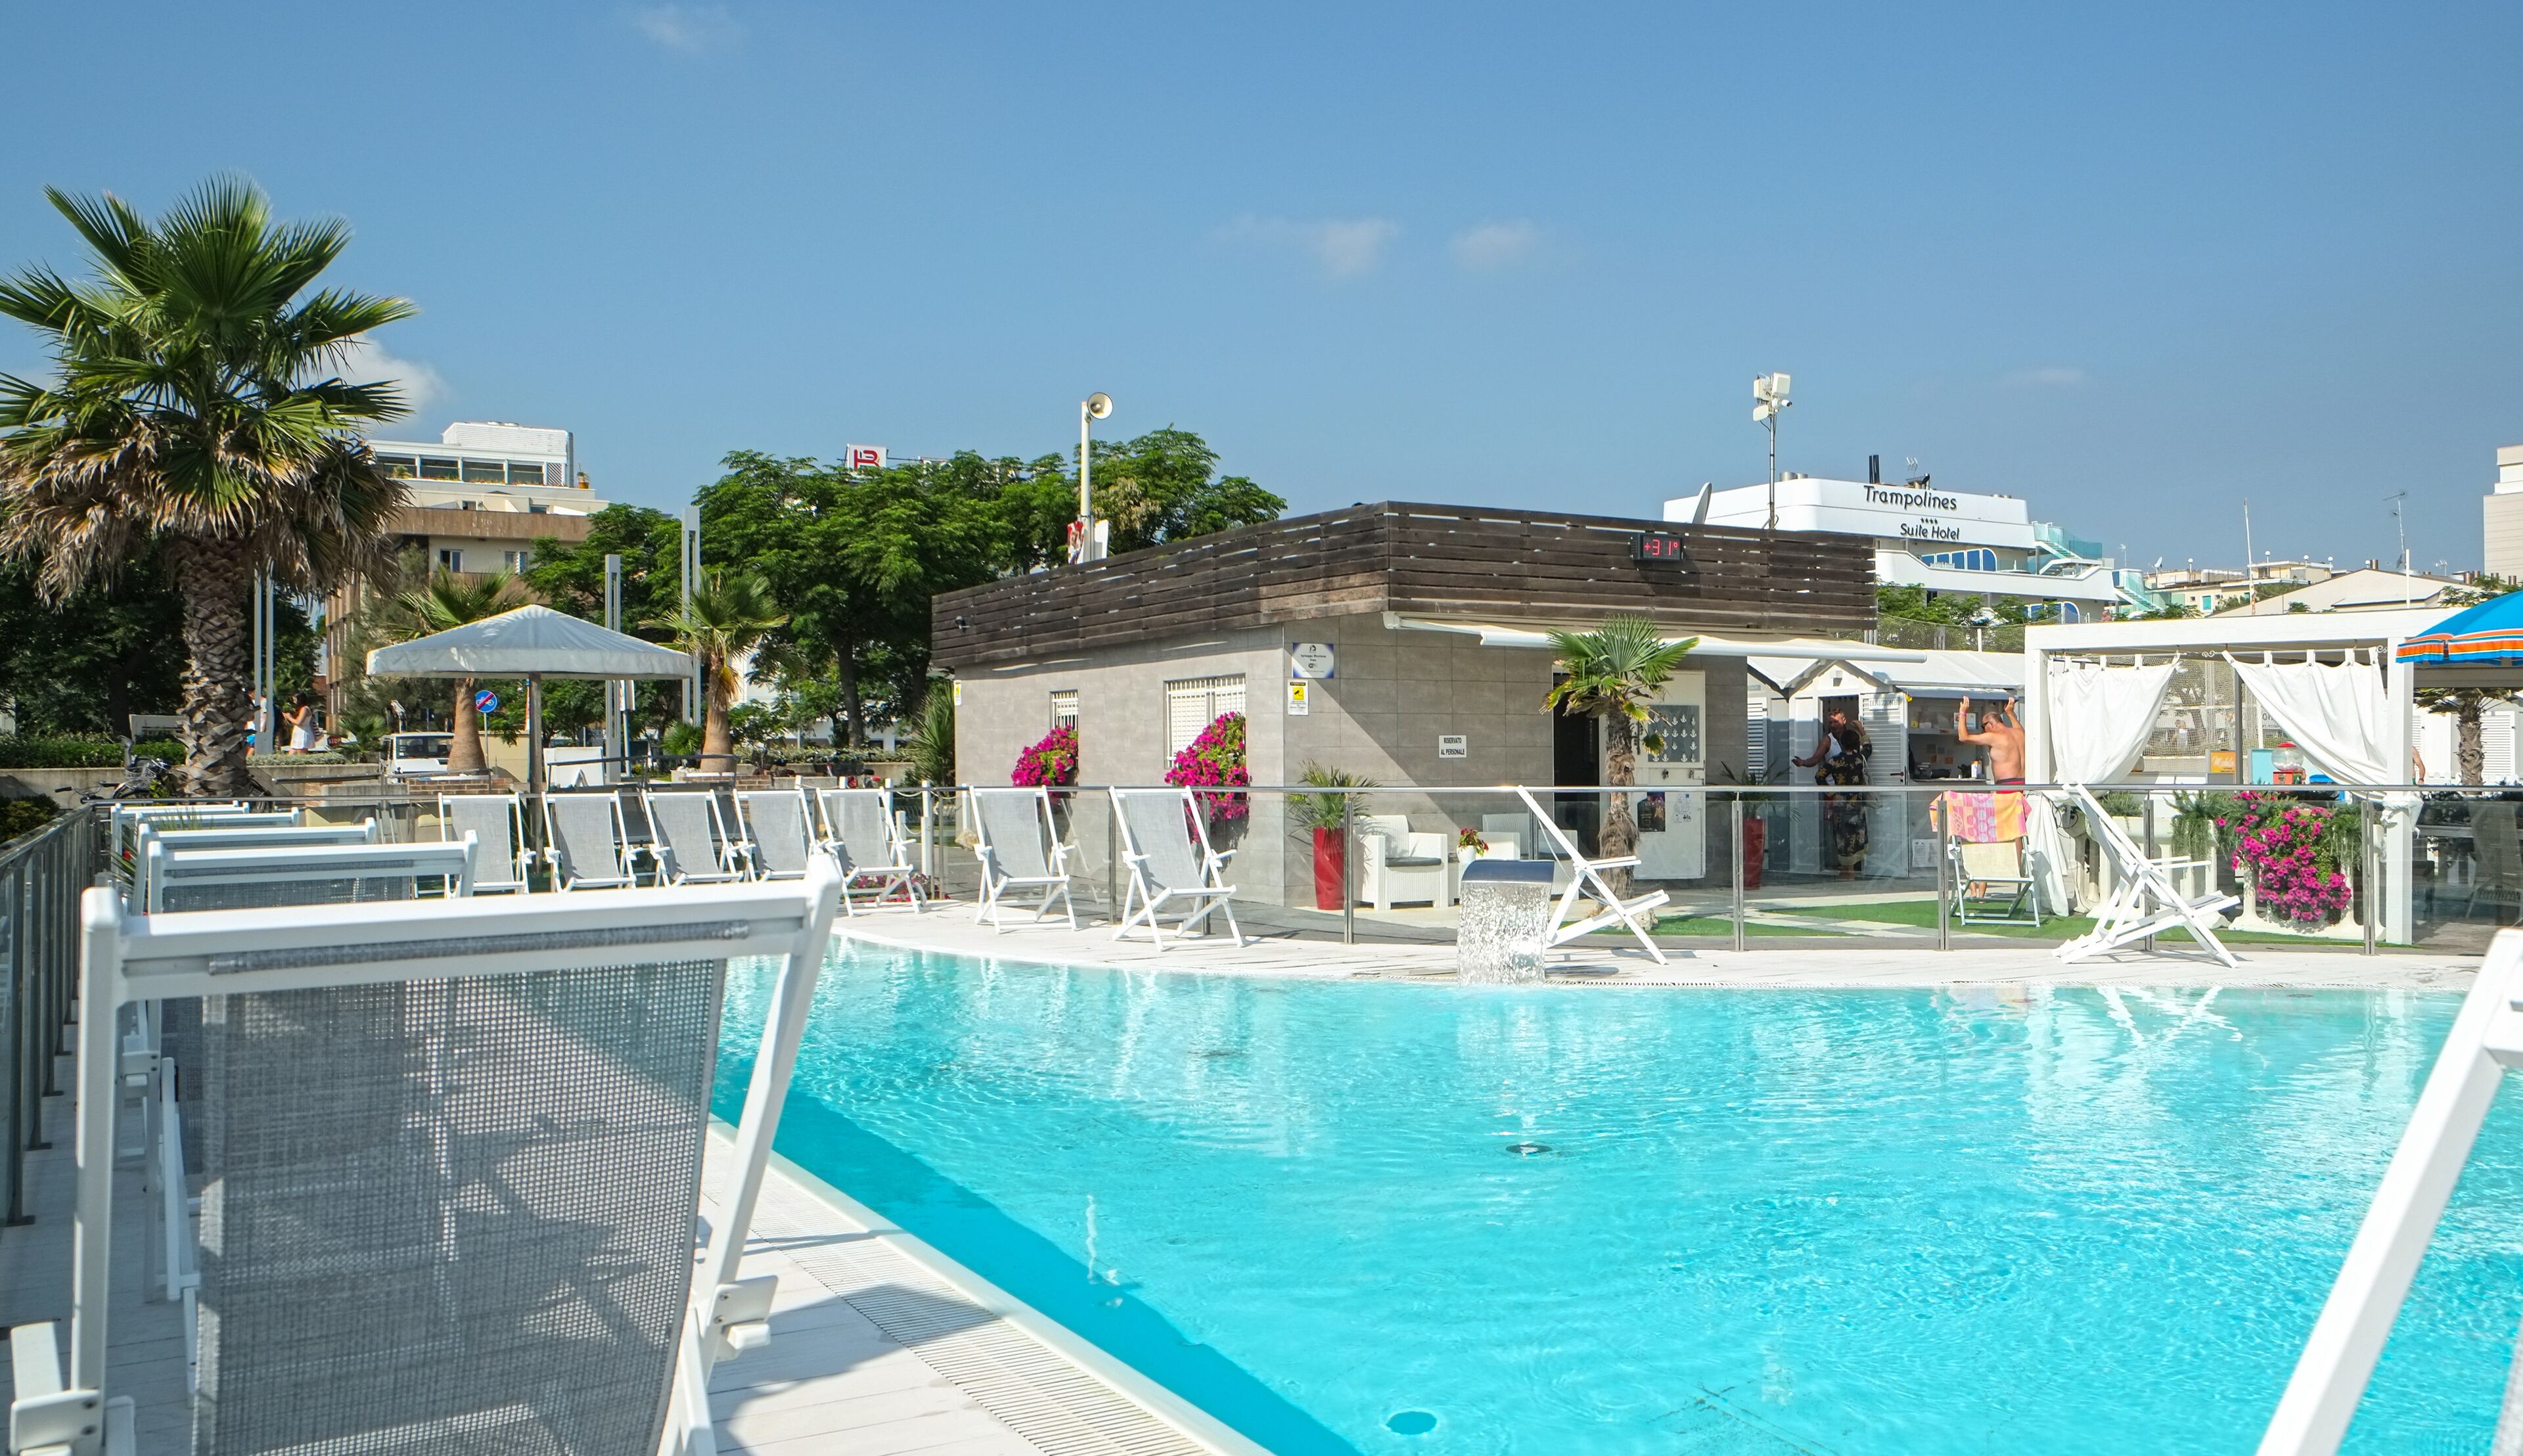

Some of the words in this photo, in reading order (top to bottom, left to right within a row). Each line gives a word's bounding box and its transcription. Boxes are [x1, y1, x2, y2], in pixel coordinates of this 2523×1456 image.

[1863, 485, 1957, 510] Trampolines
[1900, 523, 1928, 537] Suite
[1931, 526, 1960, 540] Hotel
